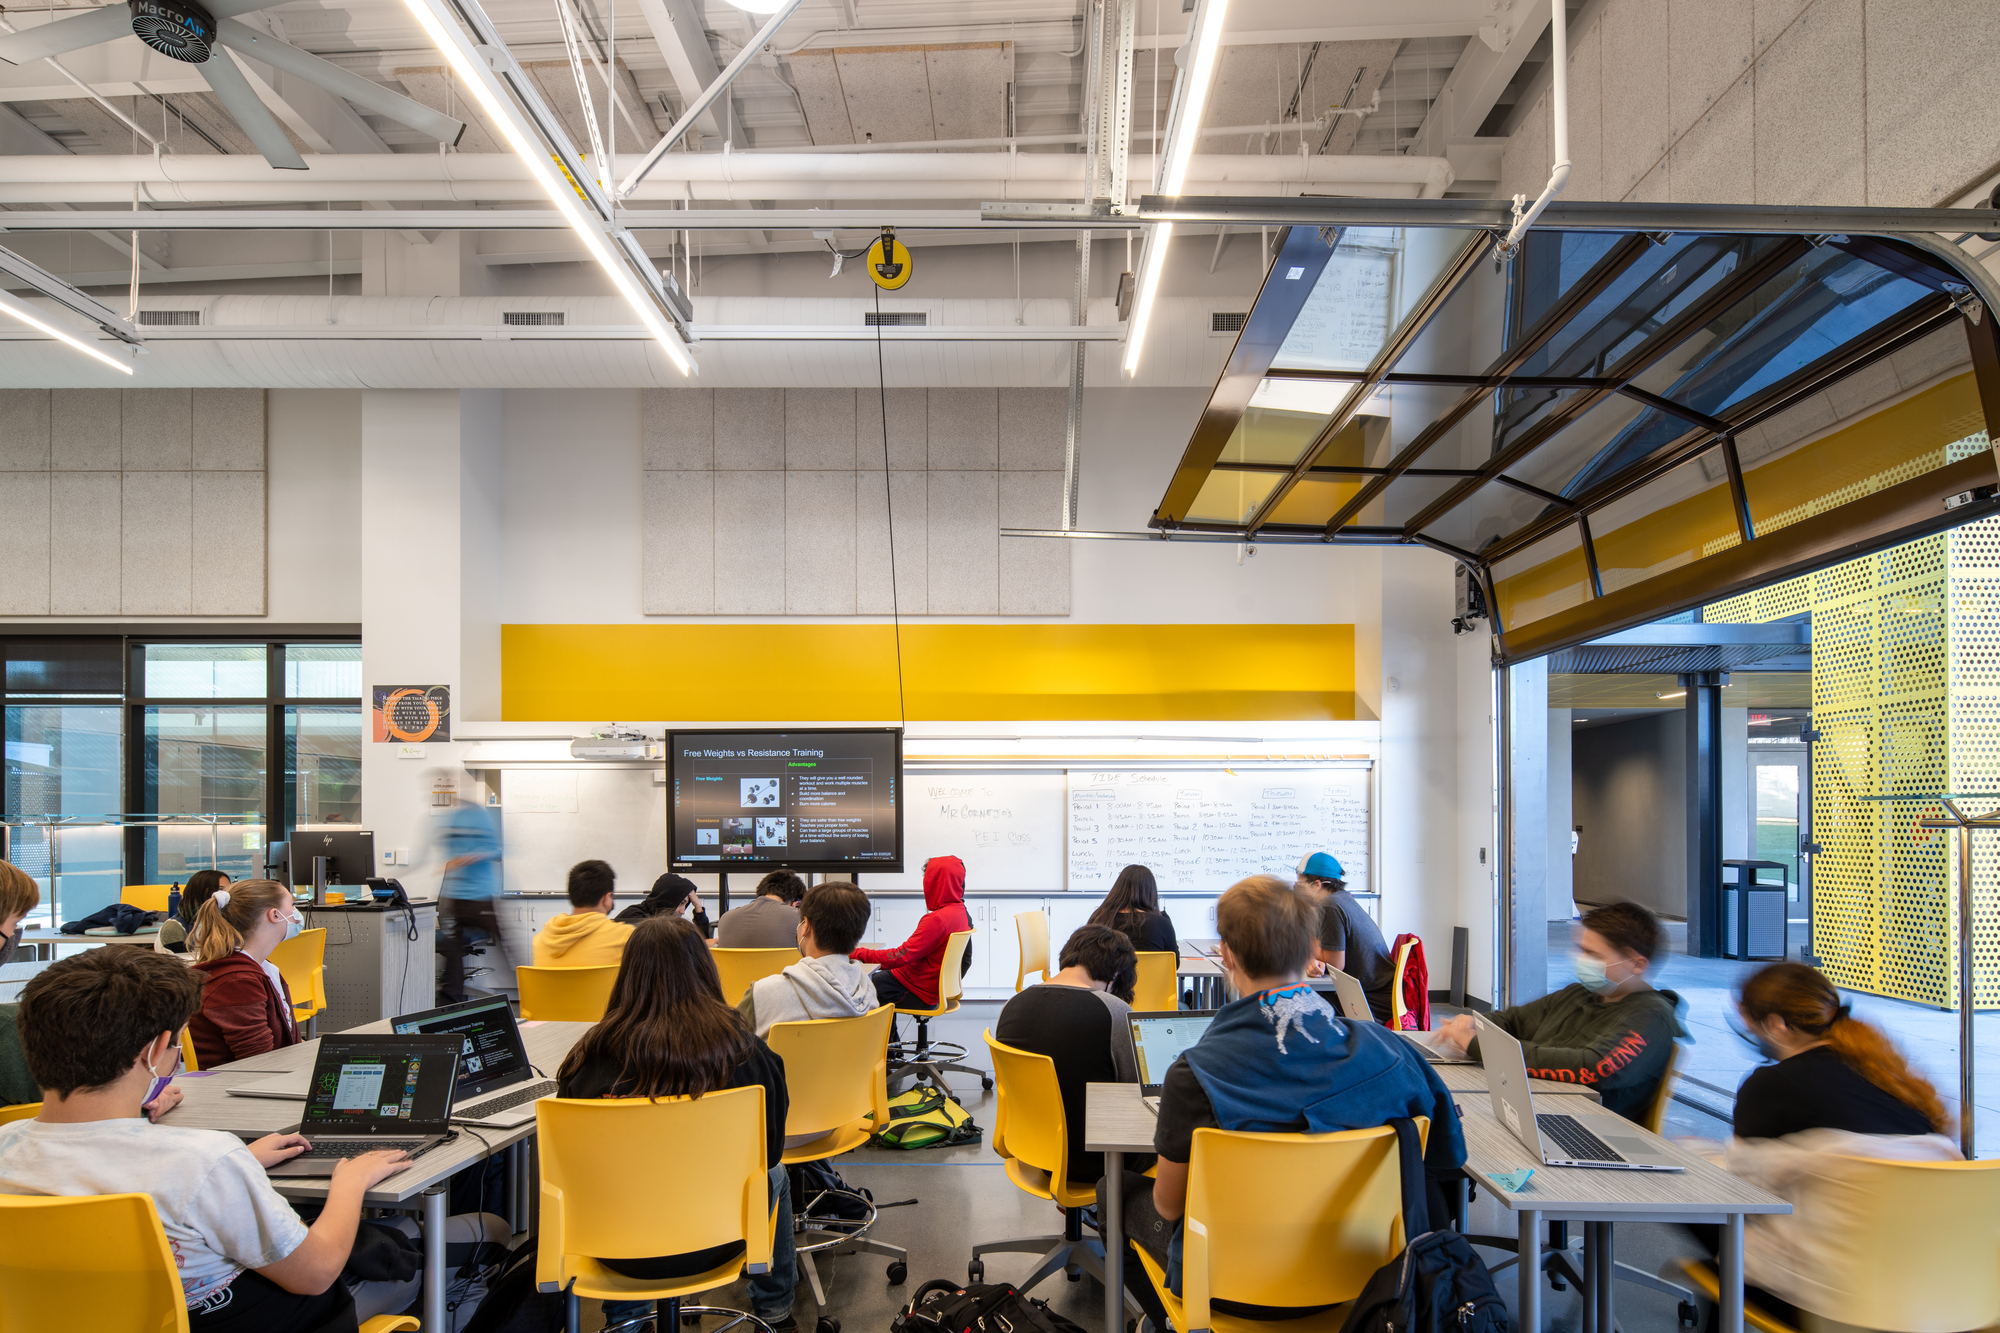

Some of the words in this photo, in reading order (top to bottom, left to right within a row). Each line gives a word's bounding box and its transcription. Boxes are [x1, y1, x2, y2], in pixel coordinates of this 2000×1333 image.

[138, 2, 206, 37] MacroAir
[704, 750, 734, 758] Weights
[792, 749, 823, 758] Training
[1092, 773, 1121, 782] TIDE
[1072, 803, 1092, 811] Period
[1070, 872, 1093, 880] Period
[1579, 1067, 1598, 1084] &
[1596, 1029, 1648, 1078] GUNN
